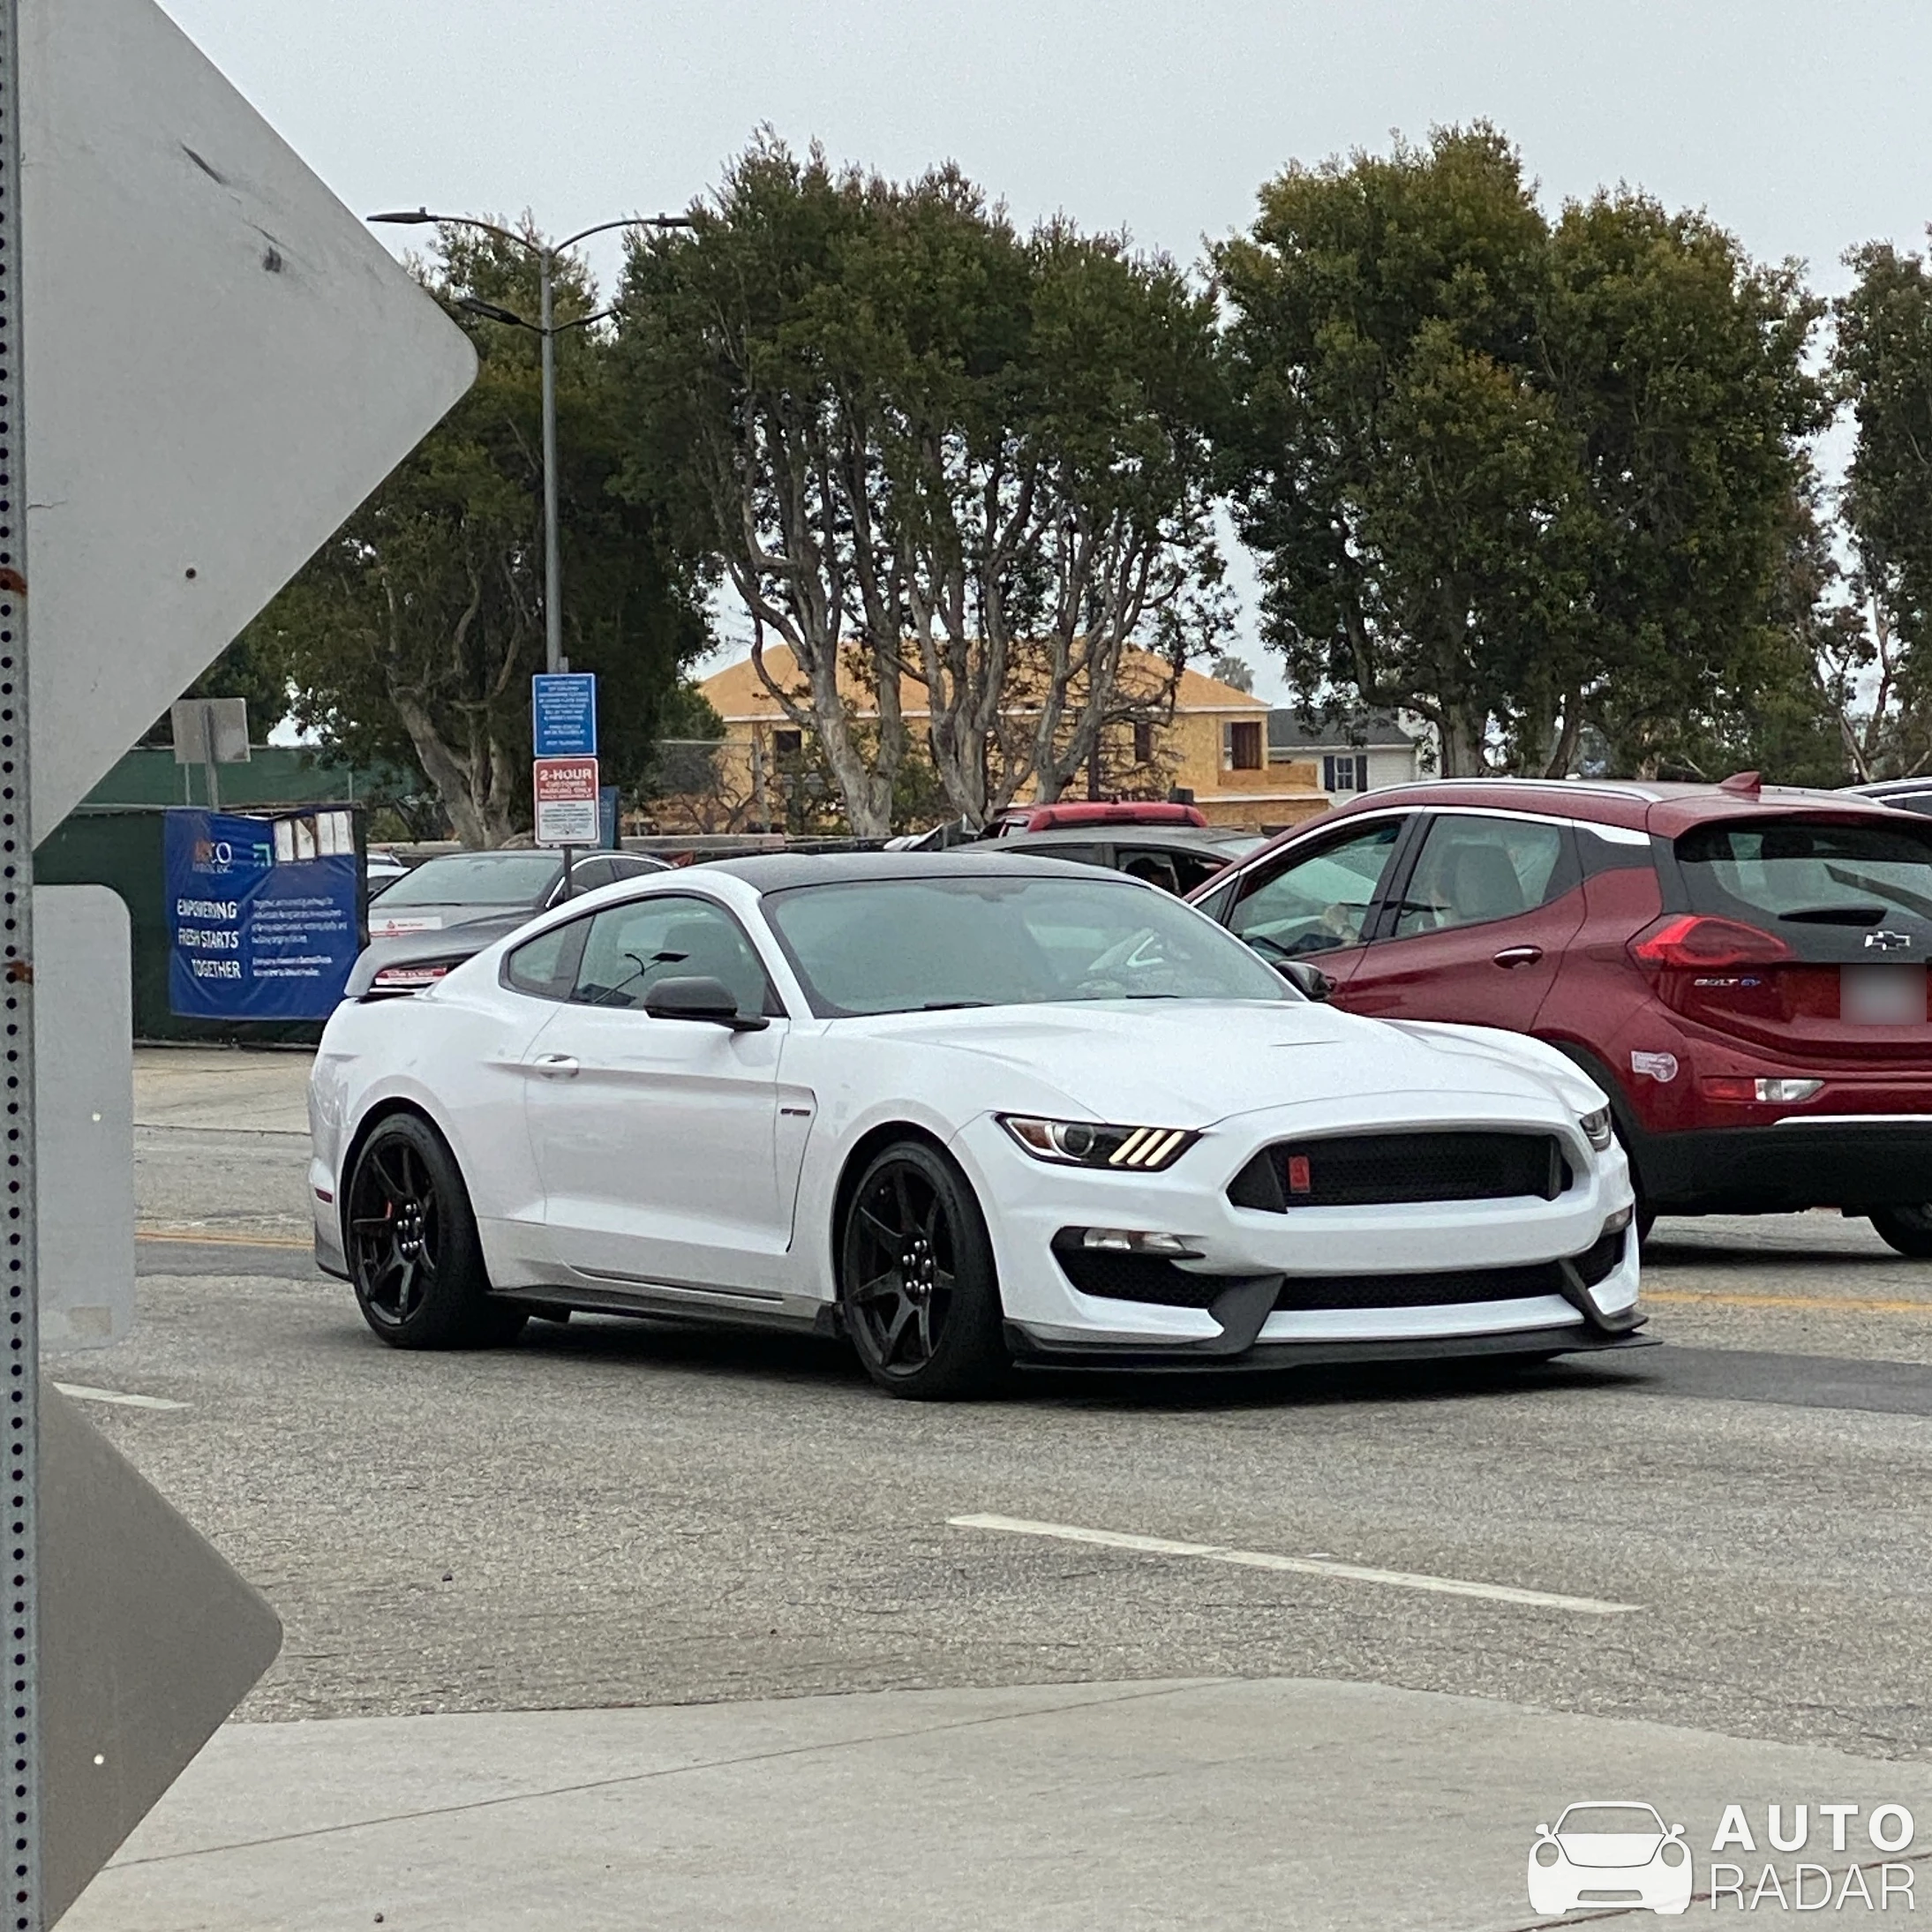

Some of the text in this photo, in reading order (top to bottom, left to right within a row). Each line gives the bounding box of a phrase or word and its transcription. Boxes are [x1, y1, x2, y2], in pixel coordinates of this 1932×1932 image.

[539, 769, 592, 781] 2-HOUR
[200, 929, 239, 949] STARTS
[191, 958, 242, 979] TOGETHER
[1694, 978, 1739, 987] BOLT
